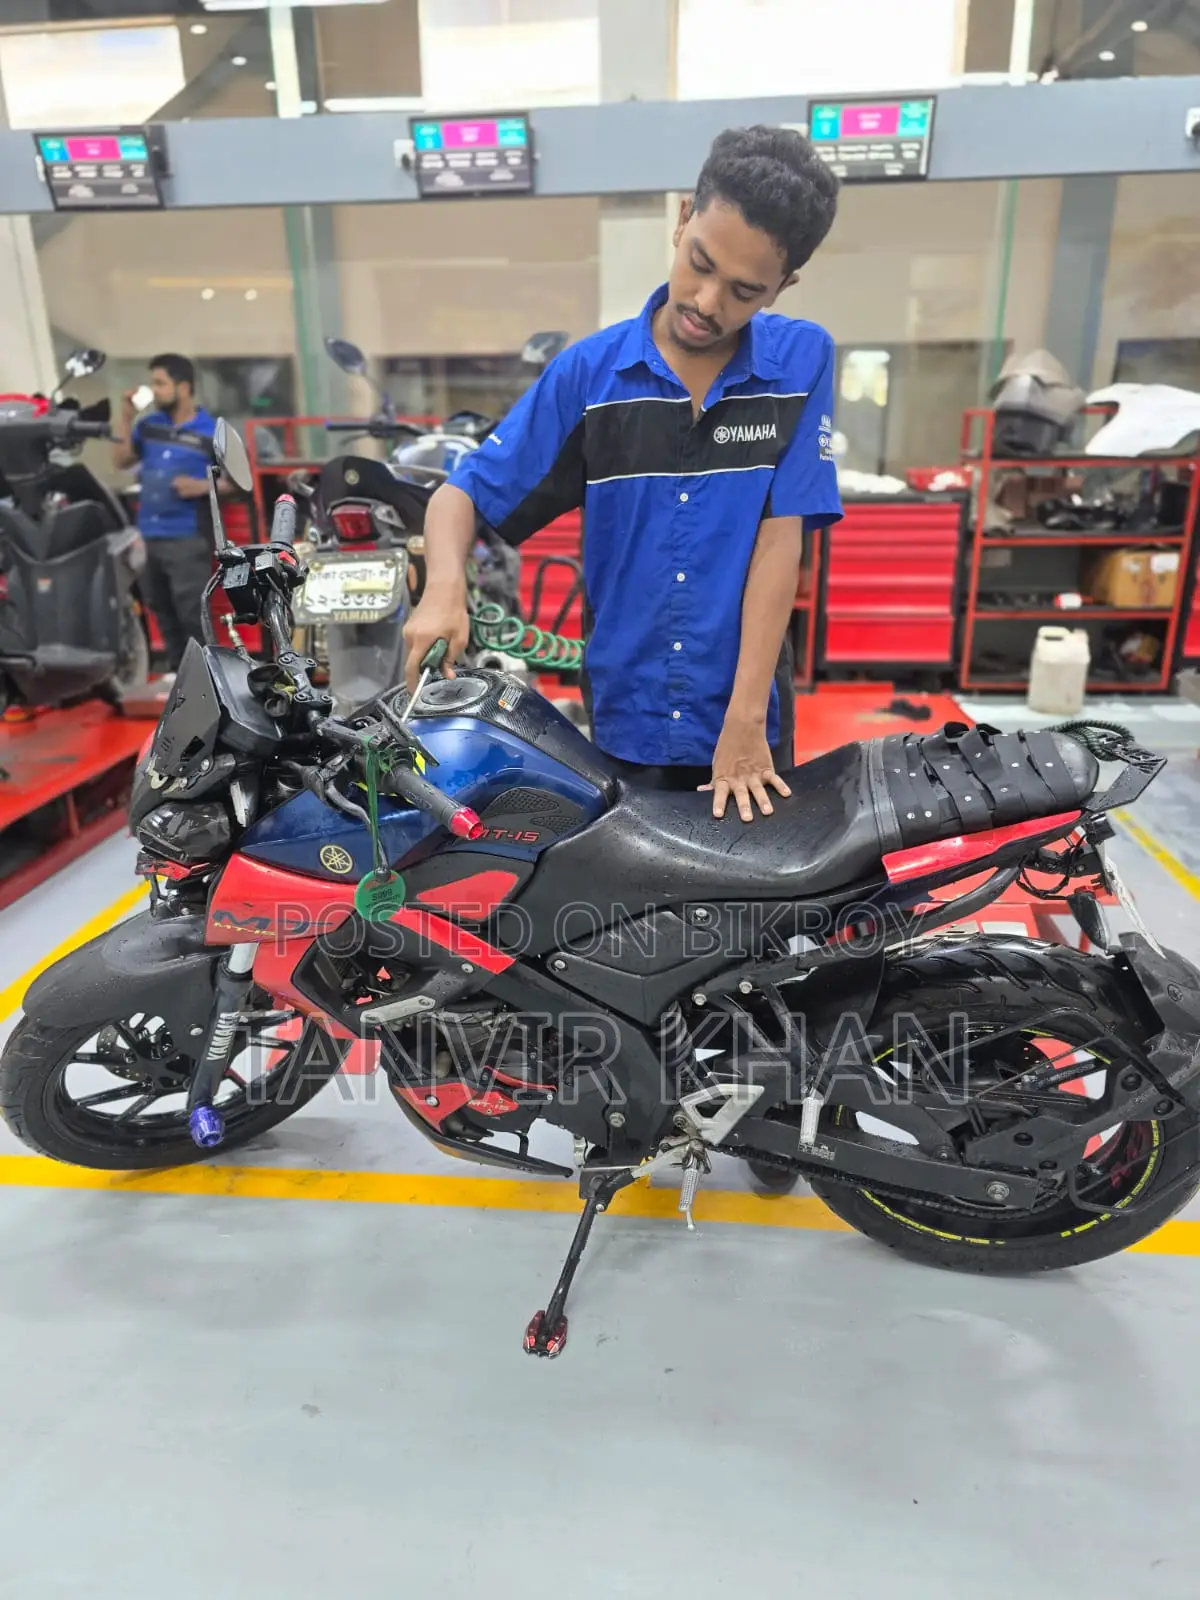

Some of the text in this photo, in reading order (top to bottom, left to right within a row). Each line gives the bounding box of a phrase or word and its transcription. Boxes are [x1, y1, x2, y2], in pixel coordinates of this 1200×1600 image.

[730, 424, 777, 442] YAMAHA
[333, 611, 380, 621] YAMAH
[206, 1011, 240, 1060] YAMAHA
